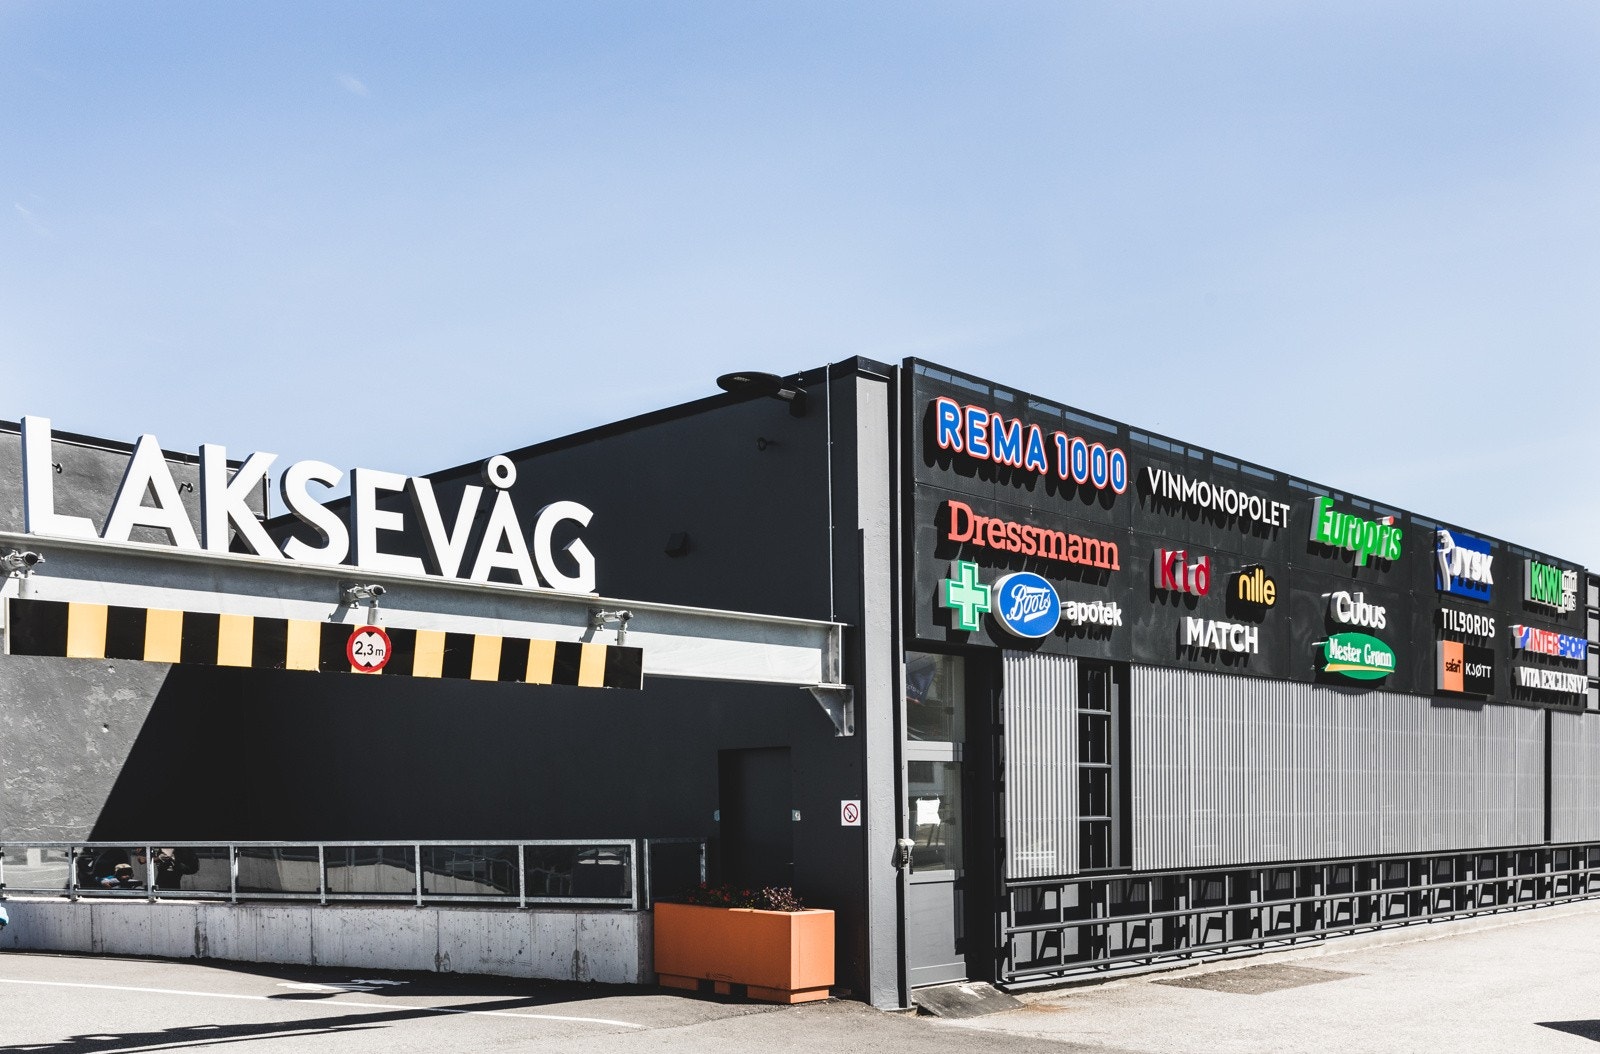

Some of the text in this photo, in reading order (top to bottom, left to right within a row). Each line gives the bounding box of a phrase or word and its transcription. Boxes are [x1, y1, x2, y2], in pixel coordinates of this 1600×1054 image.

[935, 396, 1128, 495] REMA 1000
[21, 415, 597, 594] LAKSEVÅG
[1147, 466, 1291, 529] VINMONOPOLET
[948, 500, 1120, 571] Dressmann
[1315, 496, 1403, 567] Europris
[1159, 548, 1211, 596] Kid
[1451, 546, 1494, 585] JYSK
[1531, 561, 1562, 607] KIWI
[1006, 584, 1123, 627] Boots apotek
[1238, 568, 1276, 606] nille
[1335, 590, 1387, 630] Cubus
[1441, 608, 1496, 638] TILBORDS
[354, 640, 384, 657] 2,3 m
[1186, 616, 1259, 654] MATCH
[1329, 637, 1361, 663] Mester
[1529, 626, 1588, 660] INTERSPORT
[1465, 662, 1492, 678] KJØTT
[1519, 666, 1588, 694] VITA EXCLUSIVE
